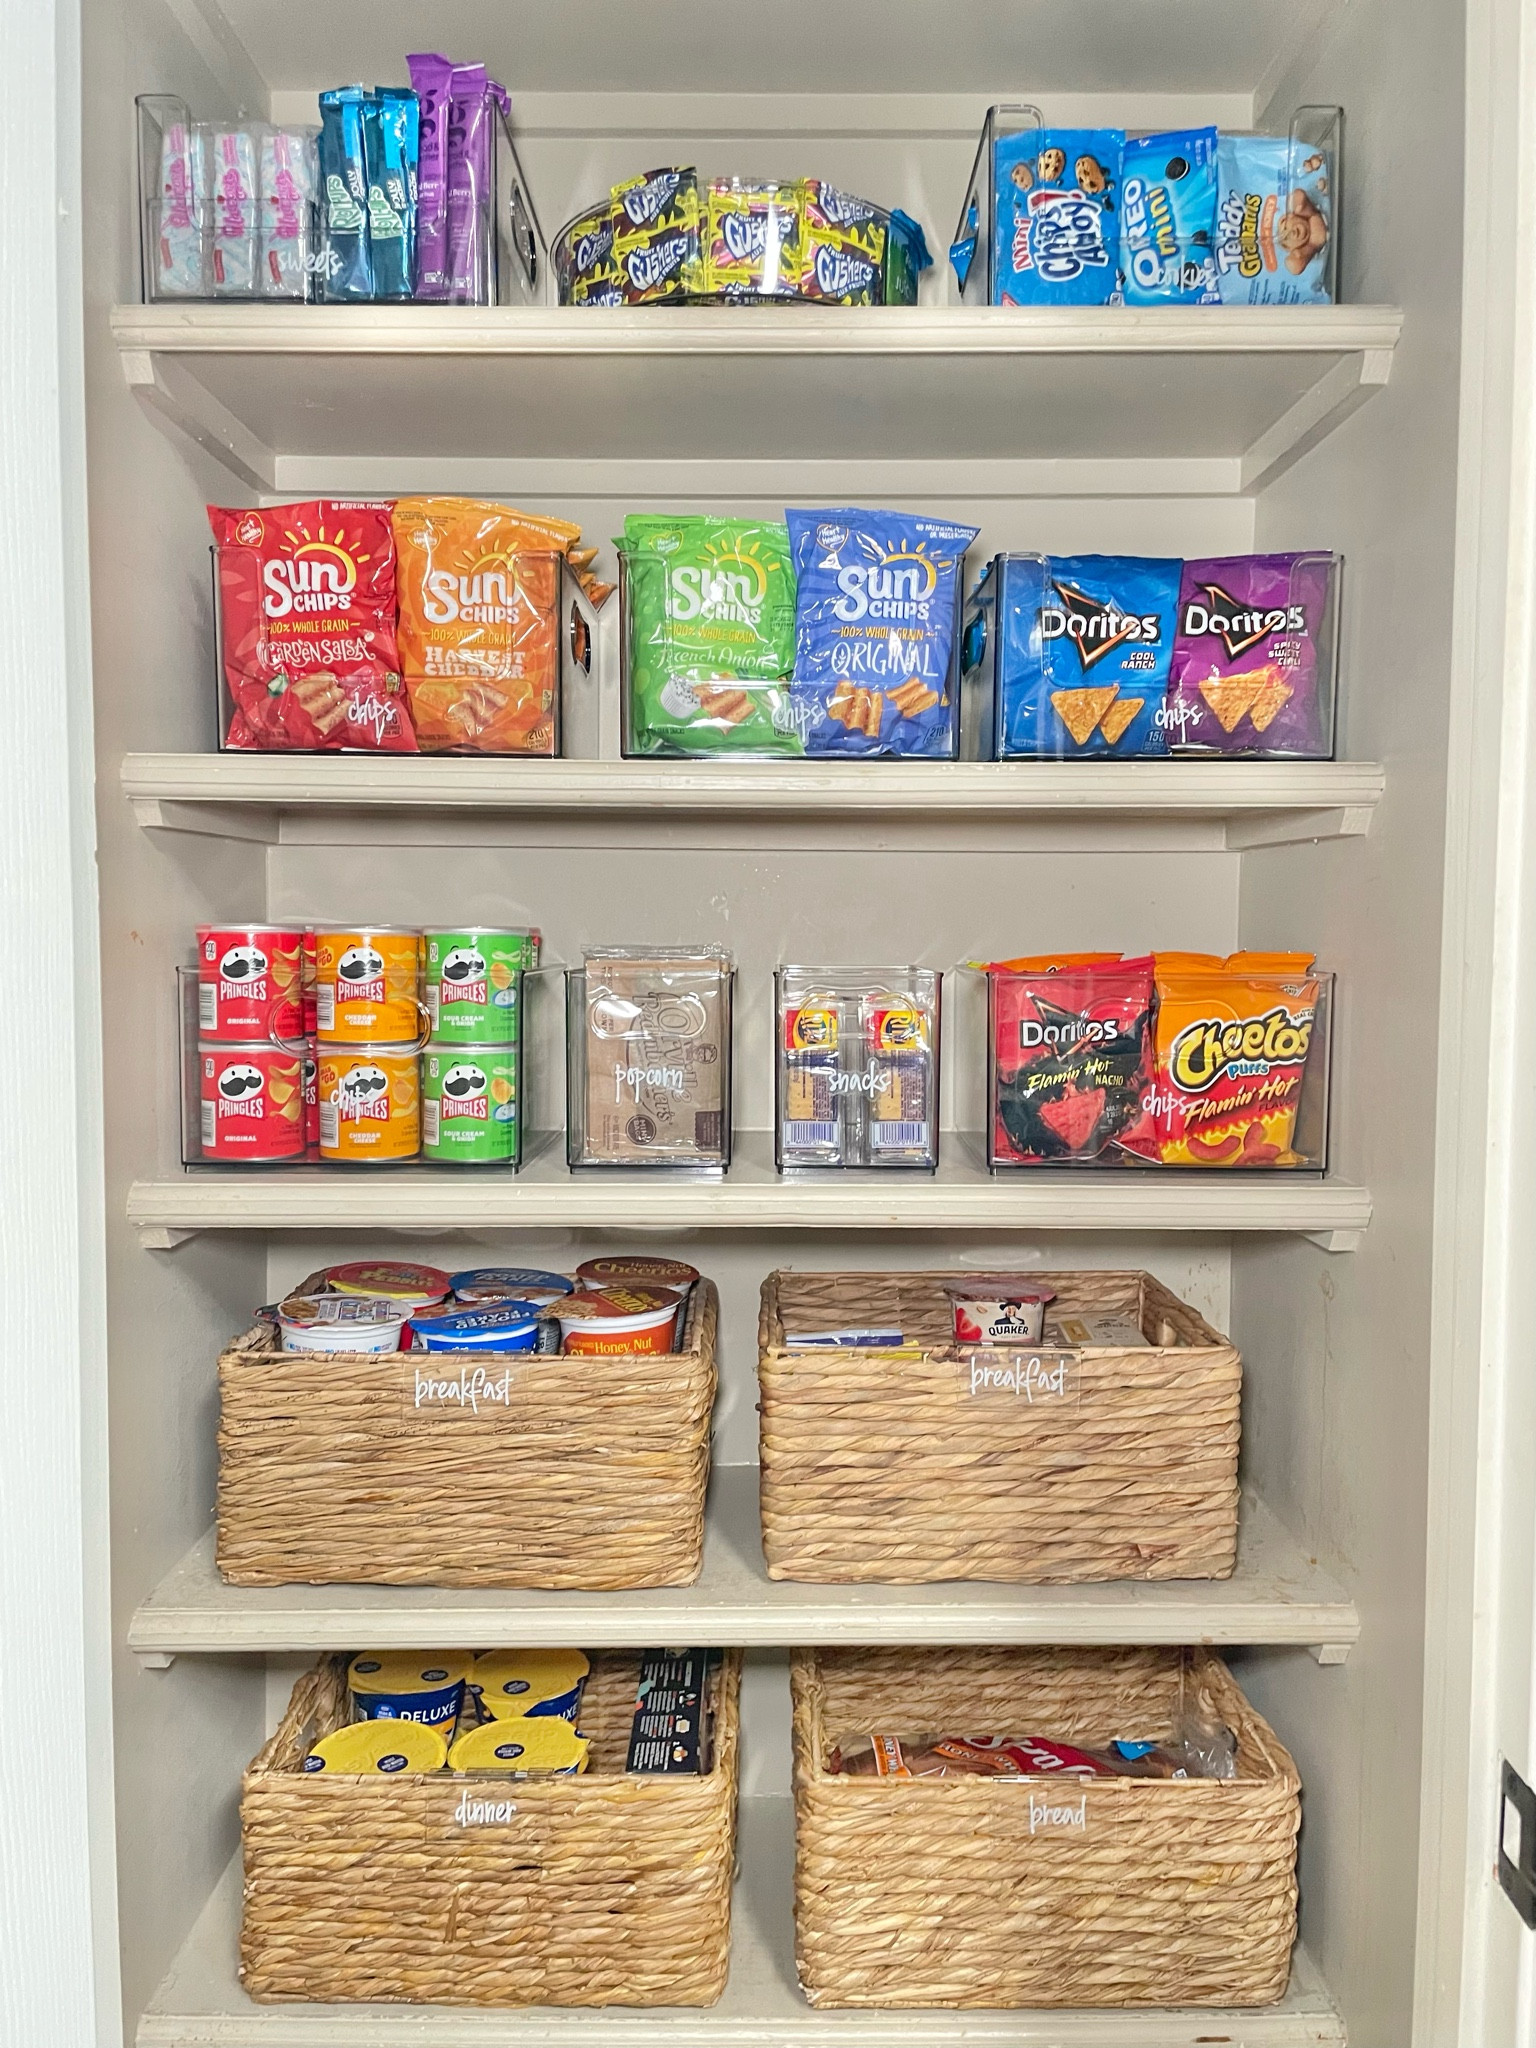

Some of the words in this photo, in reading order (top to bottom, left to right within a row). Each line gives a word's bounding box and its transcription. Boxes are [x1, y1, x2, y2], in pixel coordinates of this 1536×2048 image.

[1124, 179, 1160, 287] OREO
[1145, 188, 1176, 256] mini
[1217, 190, 1245, 275] Teddy
[1239, 194, 1262, 277] Grahams
[278, 241, 344, 280] sweets
[1014, 218, 1033, 272] Mini
[263, 558, 354, 618] Sun
[293, 593, 351, 613] CHIPS
[424, 570, 521, 624] Sun
[671, 565, 764, 621] Sun
[836, 565, 935, 621] Sun
[460, 607, 519, 625] CHIPS
[869, 600, 929, 620] CHIPS
[1042, 609, 1158, 640] Doritos
[1185, 605, 1305, 636] Doritos
[269, 620, 290, 634] 100%
[293, 619, 320, 633] WHOLE
[322, 618, 349, 632] GRAIN
[729, 629, 755, 643] GRAIN
[1121, 661, 1156, 669] RANCH
[1130, 652, 1155, 661] COOL
[348, 692, 397, 740] chips
[1155, 697, 1203, 743] chips
[220, 980, 267, 1001] PRINGLES
[337, 981, 384, 1002] PRINGLES
[442, 982, 486, 1003] PRINGLES
[1022, 1019, 1118, 1047] Doritos
[1177, 1012, 1311, 1087] Cheetos
[828, 1060, 892, 1098] snacks
[1084, 1058, 1113, 1077] Hot
[1095, 1074, 1123, 1086] NACHO
[615, 1063, 684, 1104] popcorn
[1258, 1076, 1299, 1100] Hot
[219, 1098, 264, 1118] PRINGLES
[442, 1098, 487, 1120] PRINGLES
[1142, 1083, 1188, 1132] chips
[595, 1341, 630, 1354] Honey
[633, 1337, 652, 1350] Nut
[988, 1325, 1029, 1337] QUAKER
[414, 1367, 515, 1414] breakfast
[970, 1355, 1070, 1403] breakfast
[400, 1700, 457, 1723] DELUXE
[454, 1790, 517, 1828] dinner
[1029, 1795, 1087, 1835] bread
